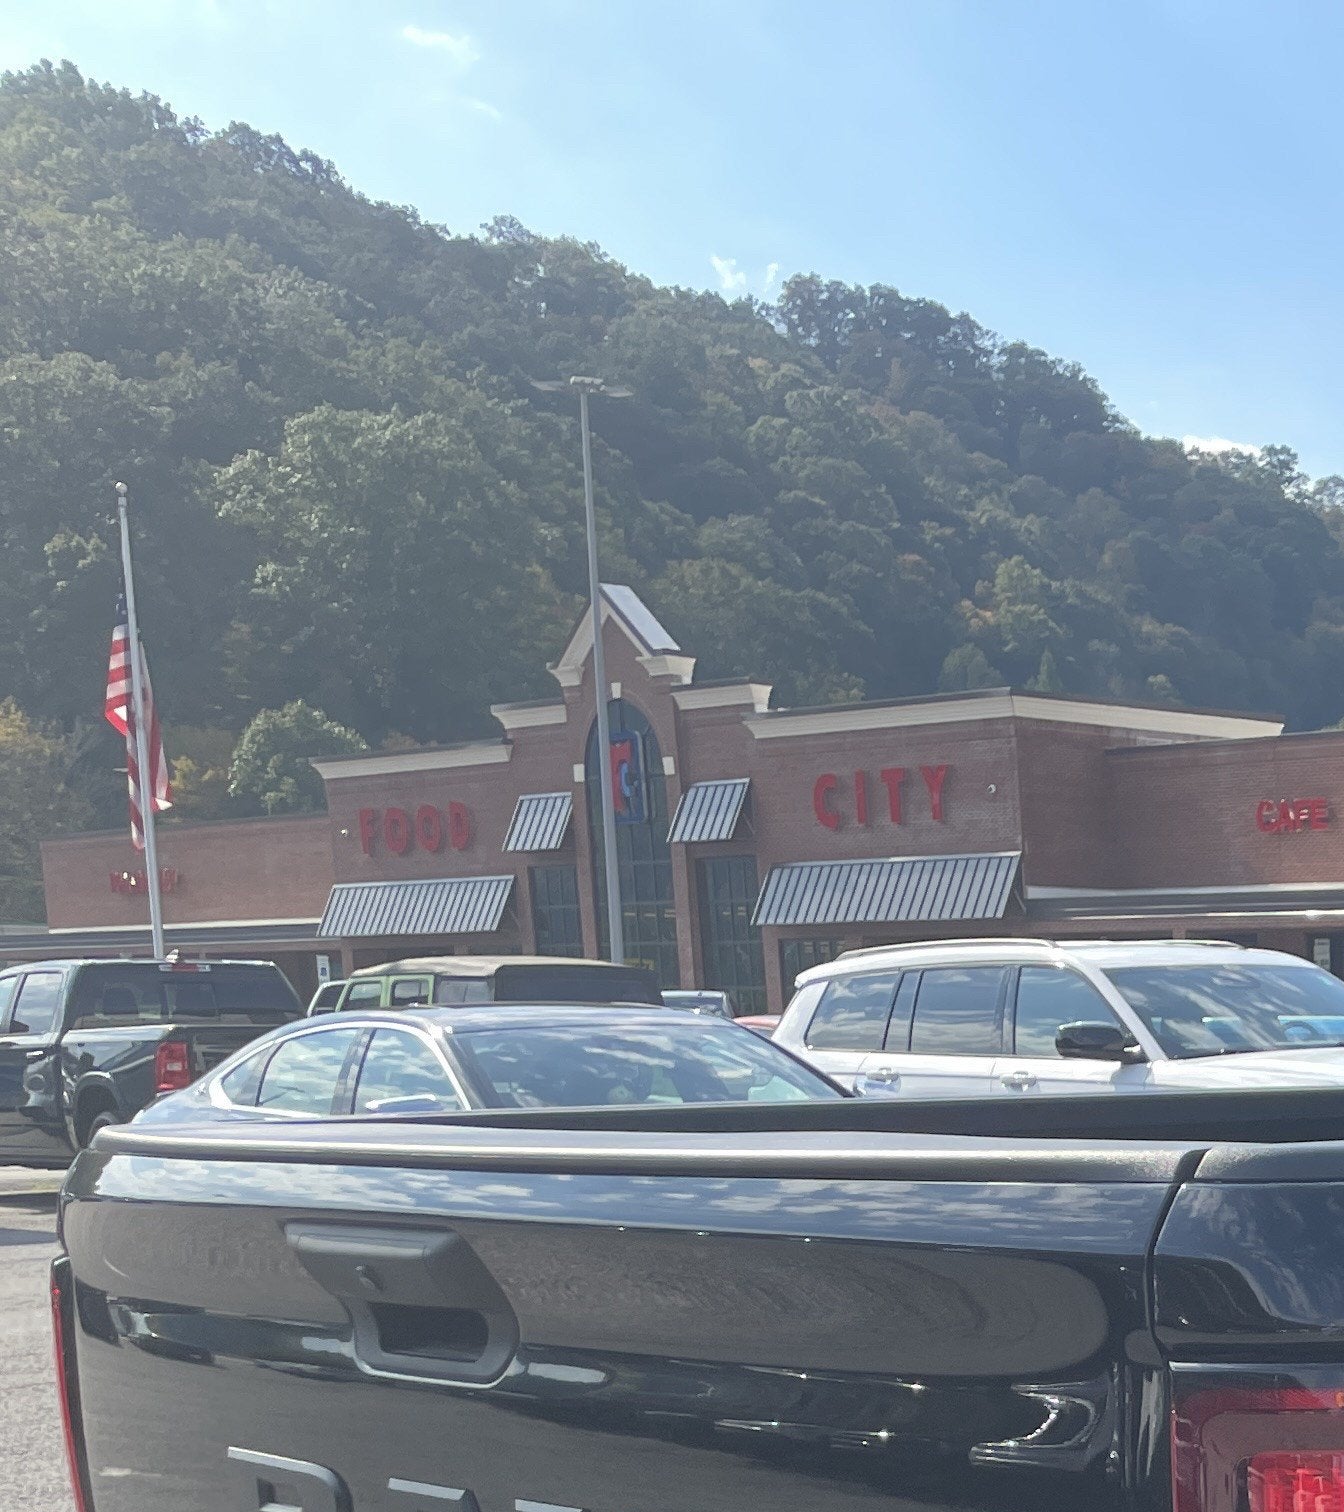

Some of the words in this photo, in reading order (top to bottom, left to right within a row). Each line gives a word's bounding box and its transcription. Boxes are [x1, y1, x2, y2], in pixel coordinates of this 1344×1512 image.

[358, 801, 470, 855] FOOD
[813, 763, 948, 831] CITY
[1255, 797, 1328, 832] CAFE
